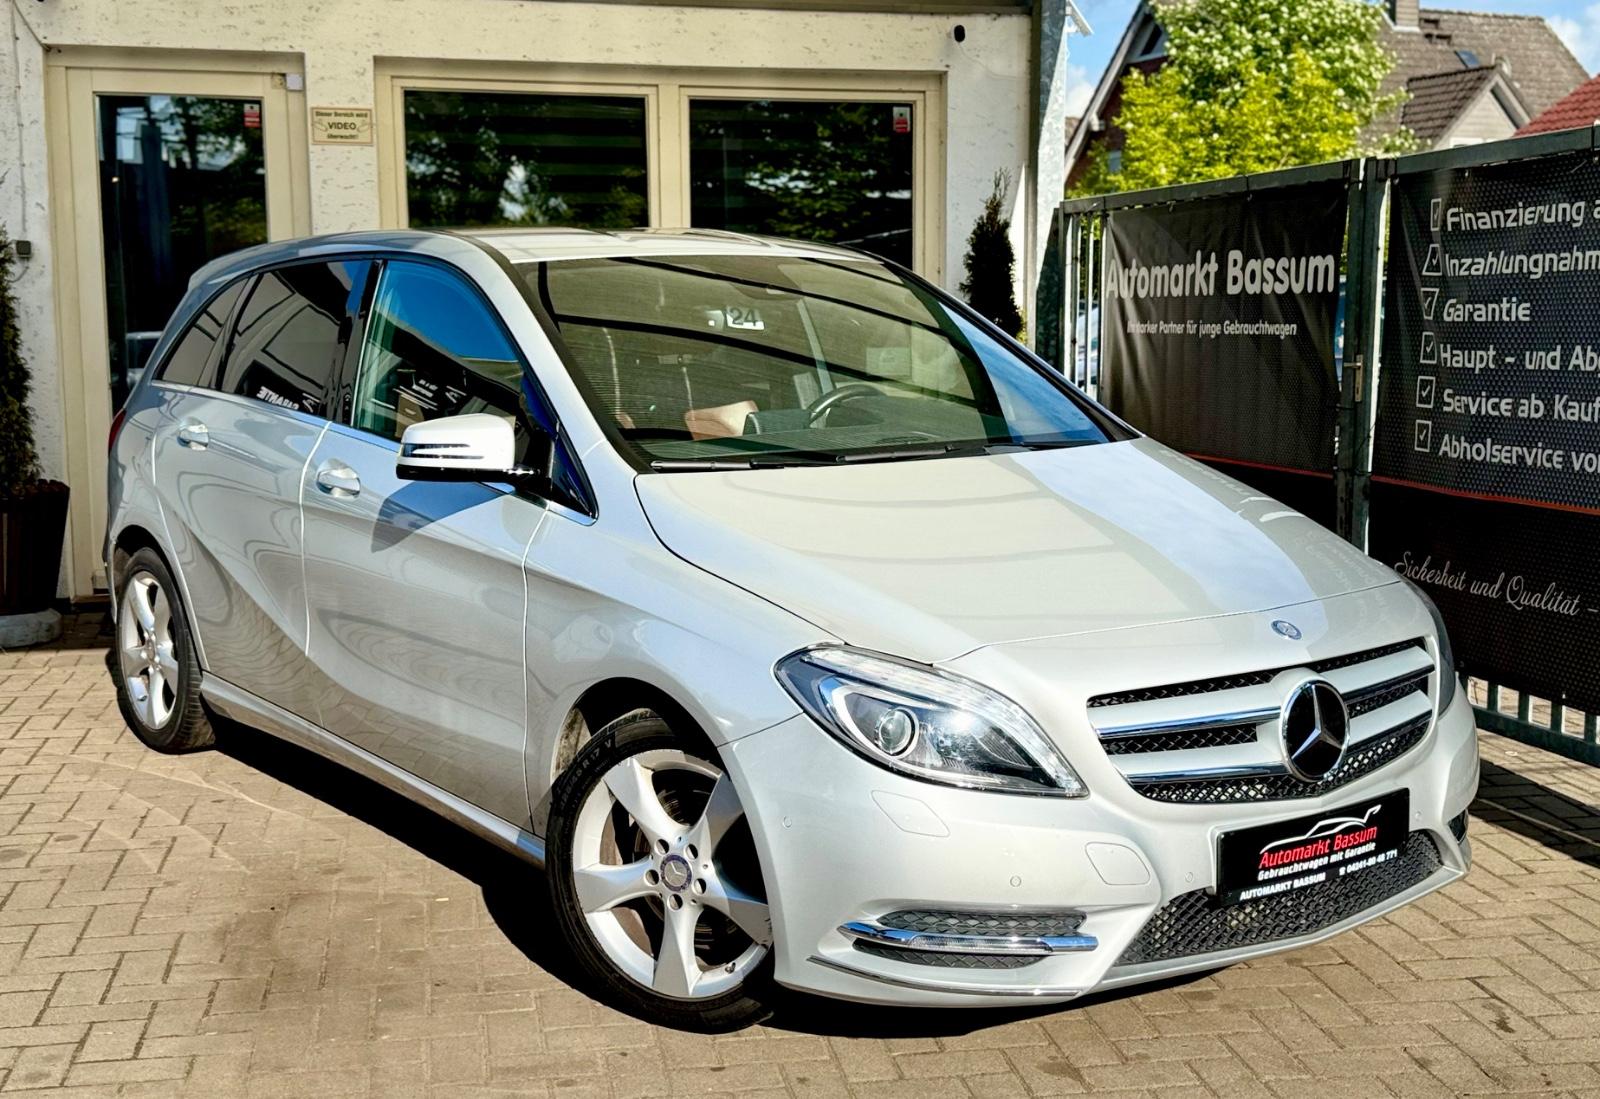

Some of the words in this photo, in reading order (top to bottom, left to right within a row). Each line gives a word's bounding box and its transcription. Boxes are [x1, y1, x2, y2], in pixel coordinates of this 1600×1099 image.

[328, 122, 357, 130] VIDEO
[1446, 201, 1585, 231] Finanzierung
[1106, 249, 1219, 299] Automarkt
[1227, 249, 1335, 295] Bassum
[1443, 297, 1531, 322] Garantie
[1159, 320, 1184, 334] Partner
[1186, 320, 1197, 334] für
[1199, 320, 1221, 338] junge
[1223, 319, 1298, 339] Gebrauchtwagen
[1440, 344, 1496, 374] Haupt
[1525, 345, 1561, 370] und
[1568, 345, 1600, 377] Ab
[1443, 388, 1513, 417] Service
[1517, 393, 1544, 418] ab
[1438, 433, 1563, 469] Abholservice
[1571, 451, 1600, 473] vo
[1394, 551, 1466, 591] Sicherheit
[1470, 572, 1505, 599] und
[1506, 575, 1580, 615] Qualität
[1258, 856, 1329, 881] Gebrauchtwagen
[1329, 851, 1344, 864] mit
[1344, 842, 1376, 859] Garantie
[1259, 838, 1331, 869] Automarkt
[1333, 826, 1378, 851] Bassum
[1240, 880, 1293, 901] AUTOMARKT
[1293, 872, 1327, 889] BASSUM
